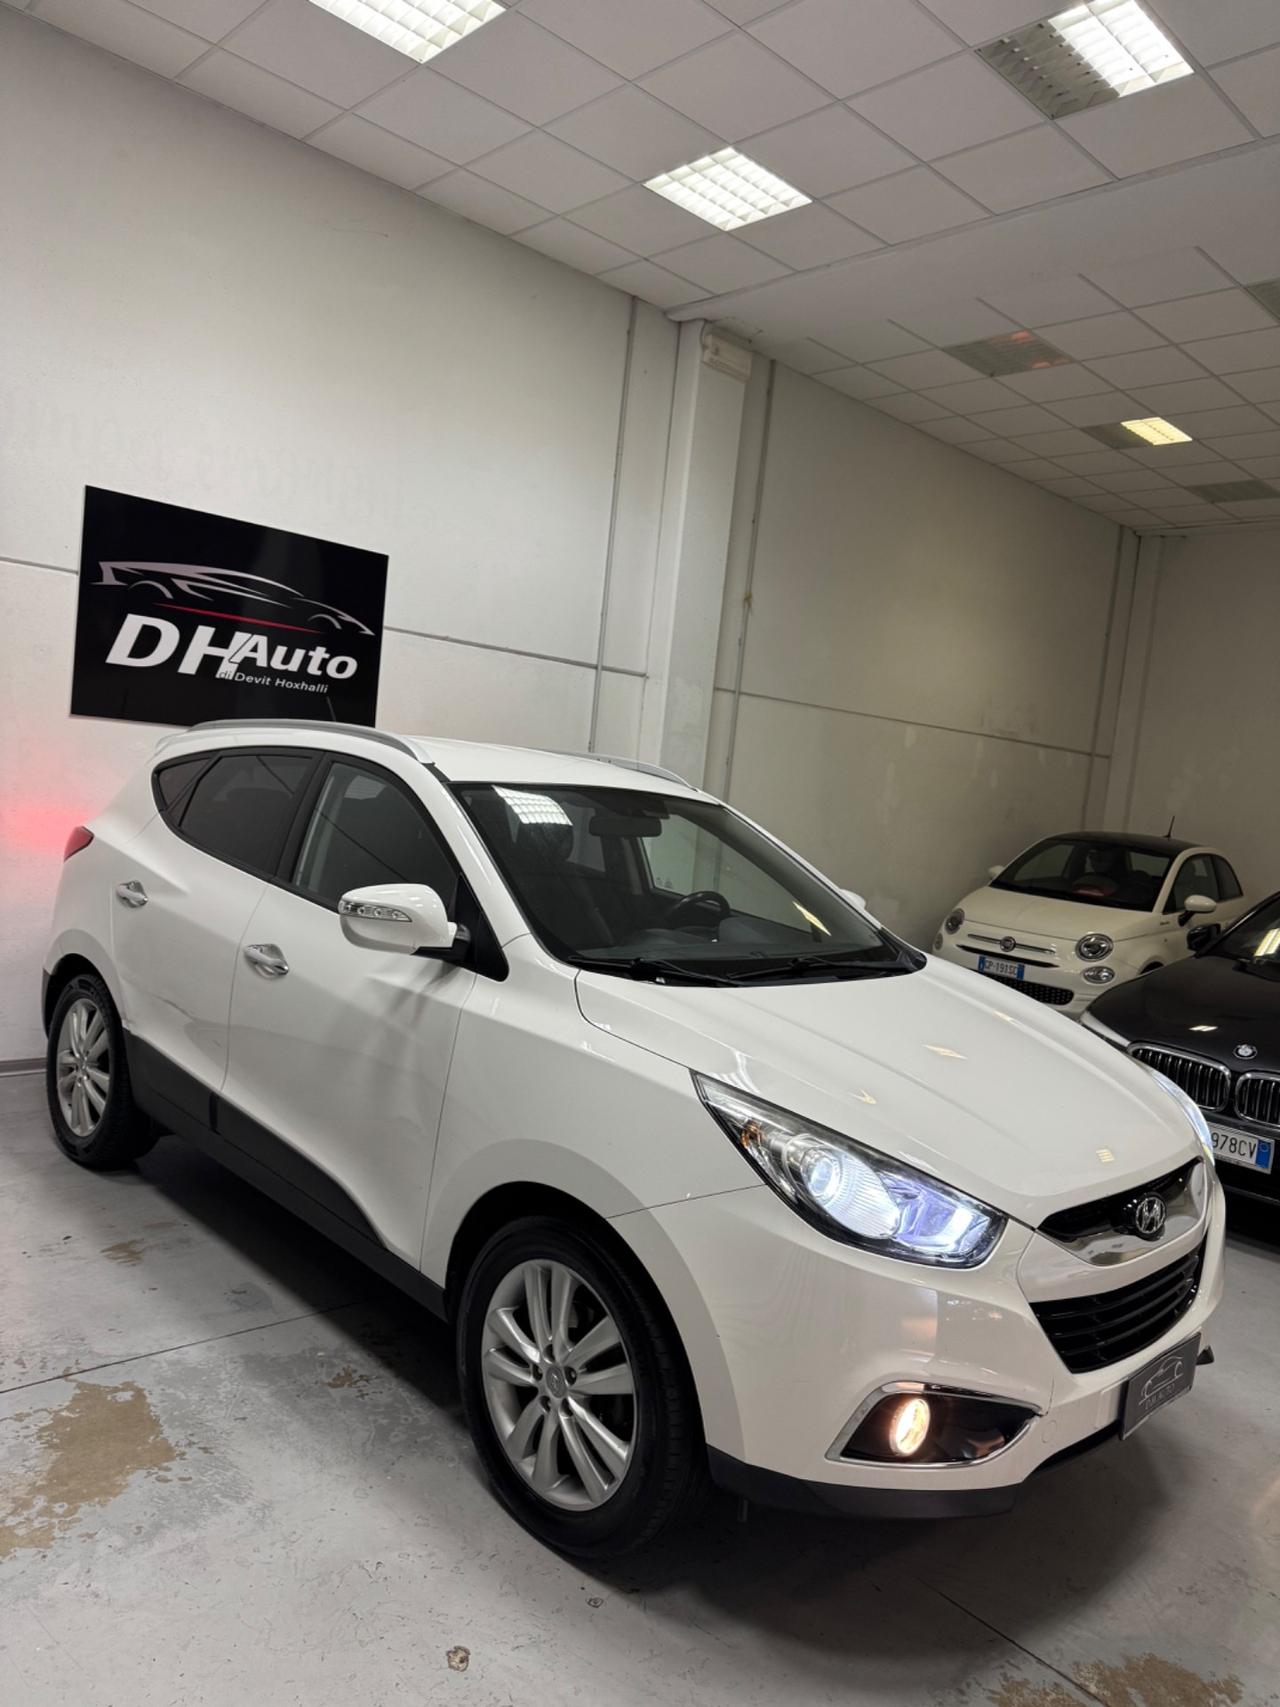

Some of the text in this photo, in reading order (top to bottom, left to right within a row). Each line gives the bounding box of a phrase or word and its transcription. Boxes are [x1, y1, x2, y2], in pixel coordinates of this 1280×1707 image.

[234, 672, 271, 686] Devit
[274, 678, 329, 694] Hoxhalli
[1211, 1131, 1256, 1159] 978CV
